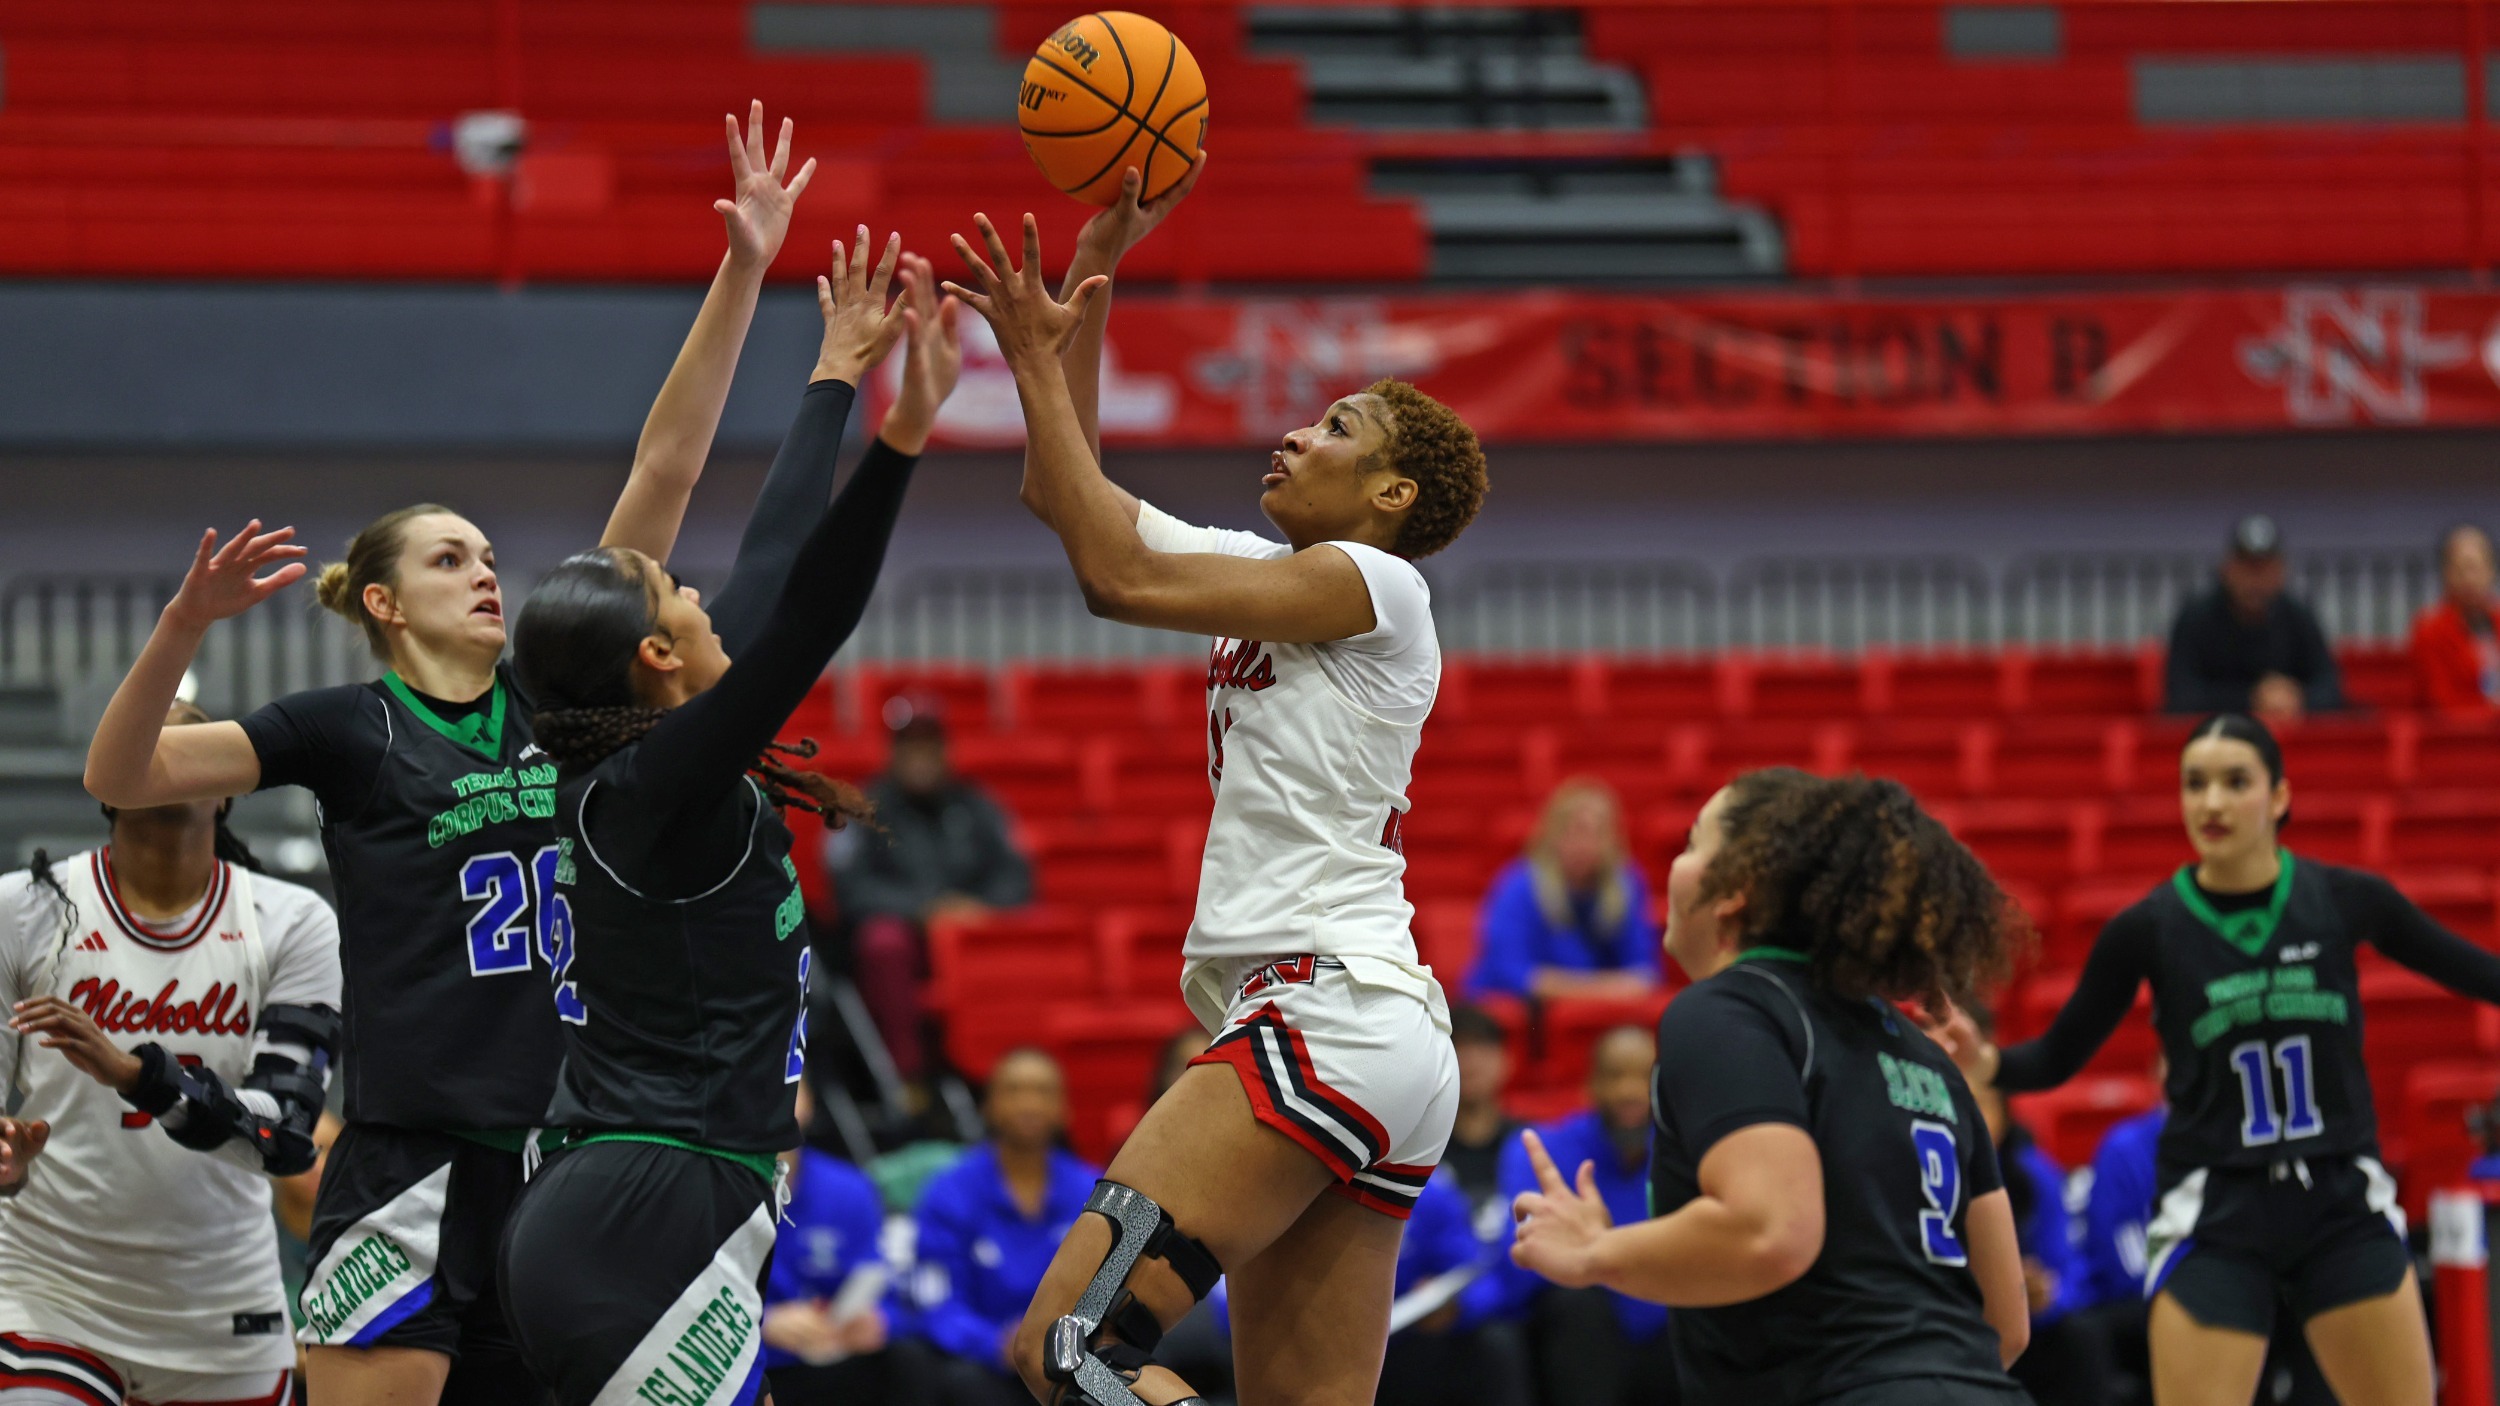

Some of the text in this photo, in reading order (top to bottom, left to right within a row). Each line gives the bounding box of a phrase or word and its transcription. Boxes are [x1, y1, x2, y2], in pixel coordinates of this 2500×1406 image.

[1020, 81, 1046, 111] VO
[1560, 320, 2002, 408] SECTION
[428, 792, 519, 848] CORPUS
[69, 976, 250, 1036] Nicholls
[2230, 1034, 2325, 1147] 11
[308, 1230, 411, 1345] ISLANDERS
